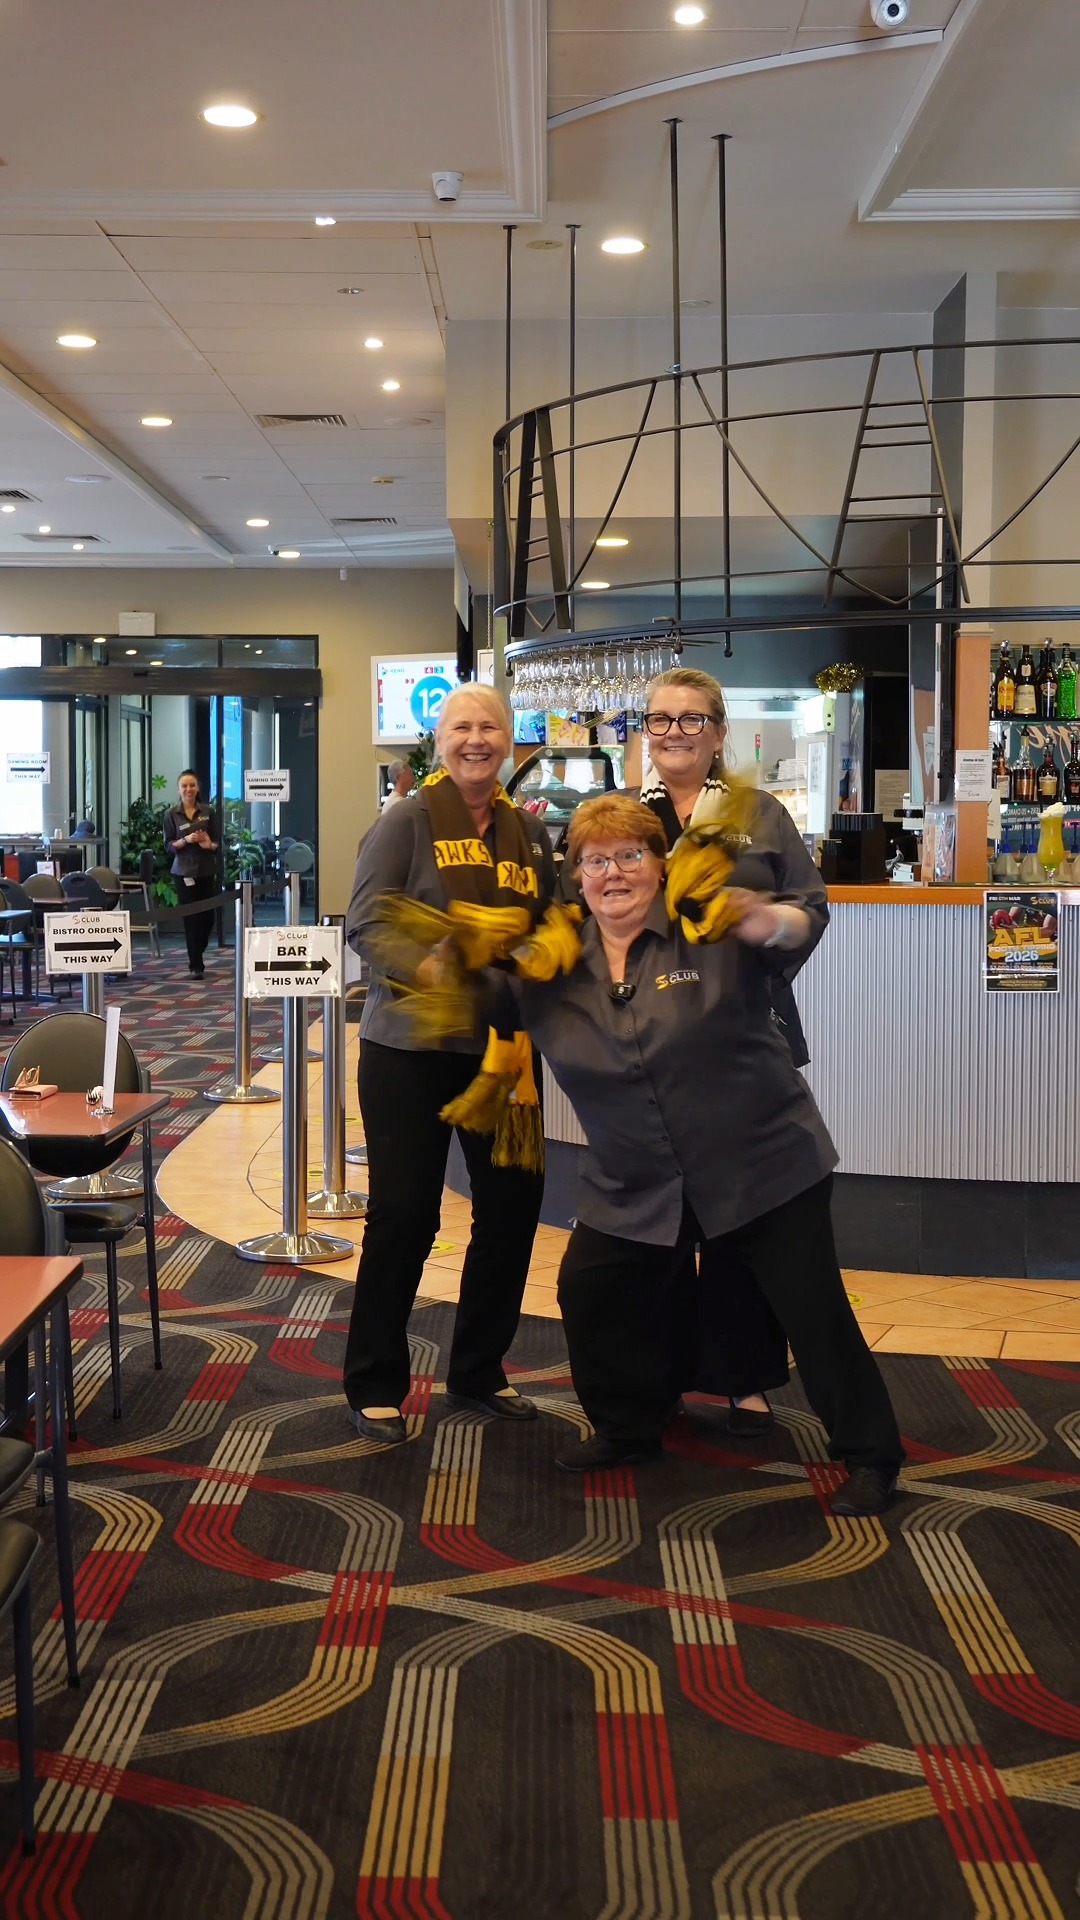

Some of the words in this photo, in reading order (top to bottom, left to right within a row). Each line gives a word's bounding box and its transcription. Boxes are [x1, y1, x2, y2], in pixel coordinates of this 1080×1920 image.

[418, 687, 447, 718] 12
[88, 926, 124, 934] ORDERS
[994, 926, 1051, 947] AFL
[277, 946, 307, 956] BAR
[63, 955, 88, 964] THIS
[90, 955, 113, 963] WAY
[1004, 950, 1039, 963] 2026
[264, 977, 291, 986] THIS
[295, 977, 320, 985] WAY
[669, 972, 700, 983] CLUB
